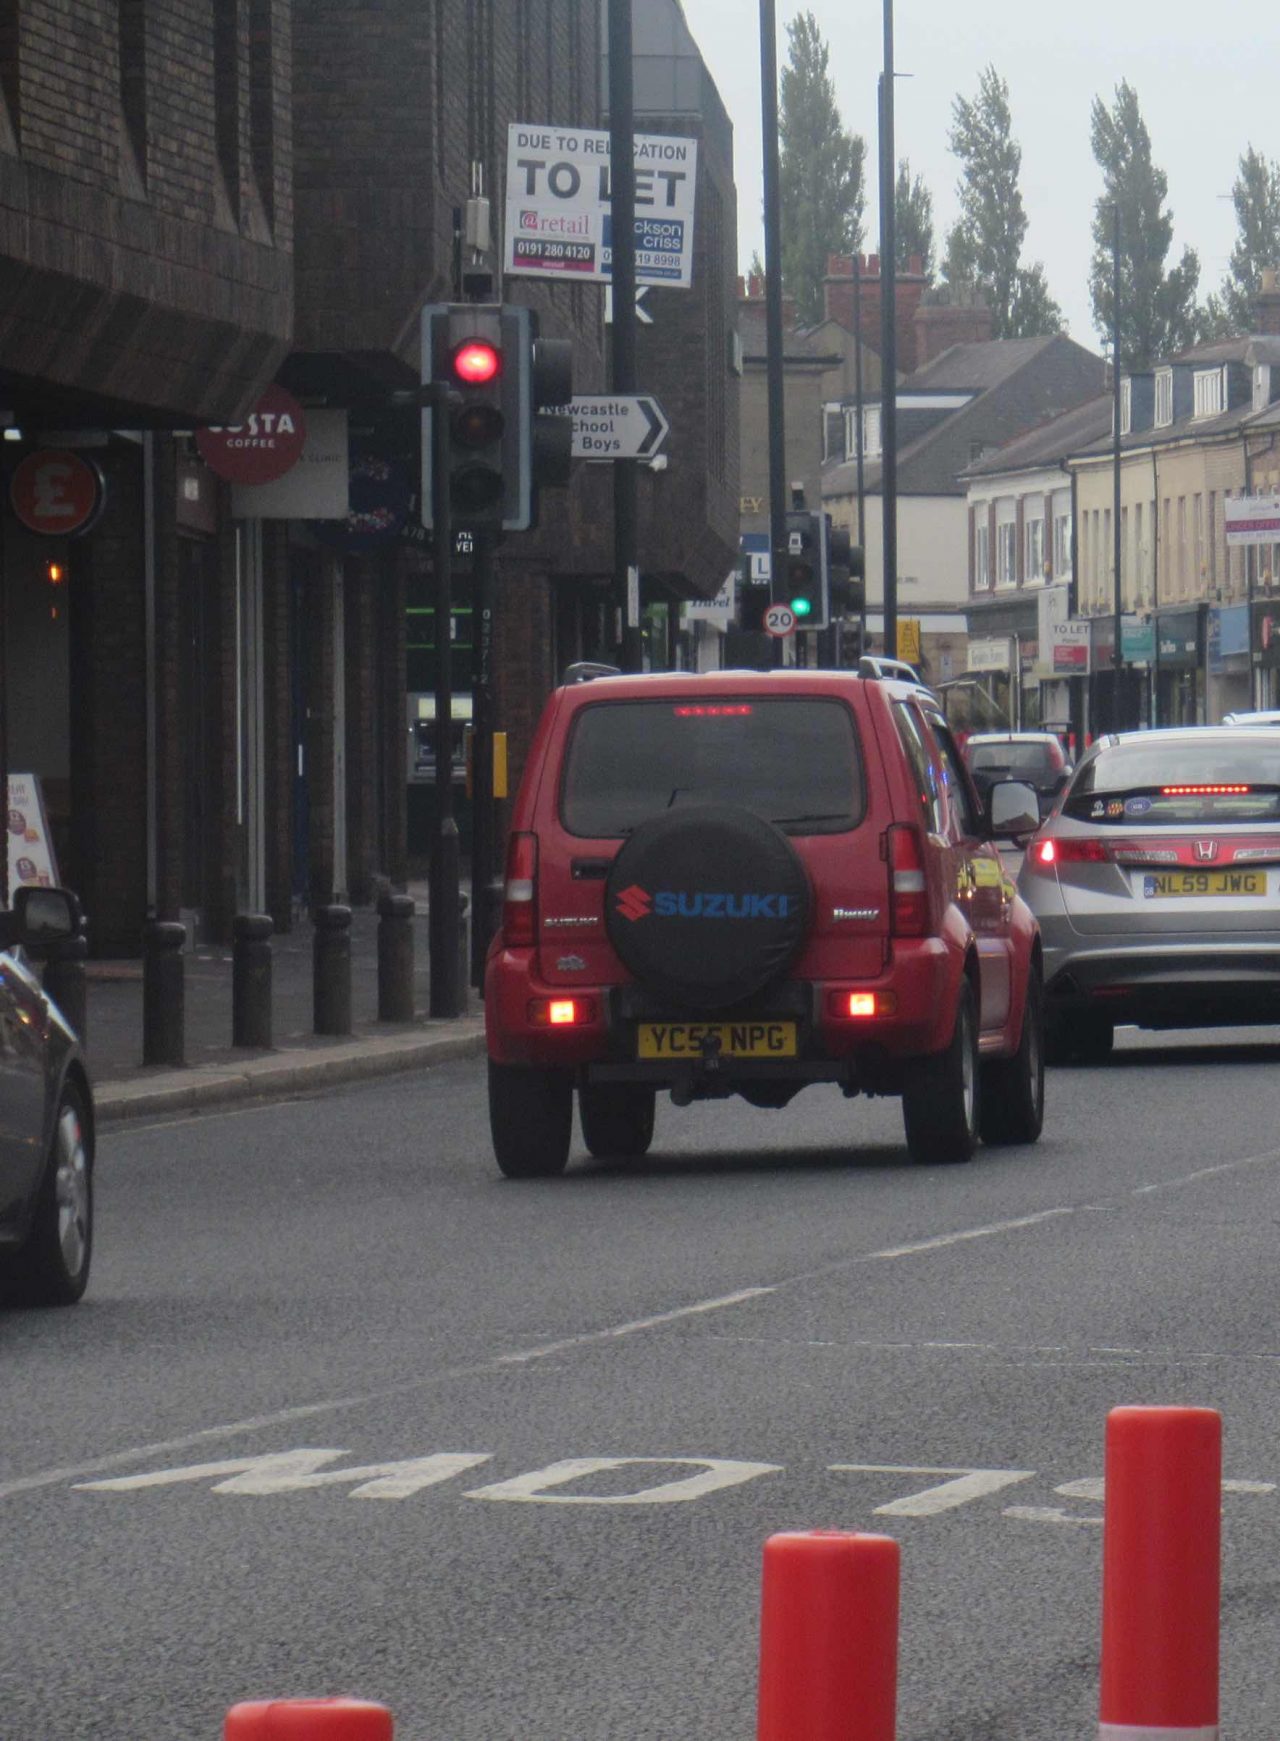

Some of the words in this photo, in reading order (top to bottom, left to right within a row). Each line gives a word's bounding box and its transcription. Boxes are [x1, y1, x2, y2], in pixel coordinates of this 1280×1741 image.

[517, 133, 551, 150] DUE
[556, 136, 578, 152] TO
[517, 159, 581, 199] TO
[517, 241, 542, 255] 0191
[544, 244, 564, 258] 280
[565, 246, 591, 260] 4120
[642, 235, 682, 249] criss
[208, 412, 296, 435] STA
[571, 420, 615, 433] chool
[226, 438, 276, 449] COFFEE
[582, 436, 621, 453] Boys
[768, 613, 792, 627] 20
[1053, 624, 1068, 635] TO
[1070, 624, 1089, 635] LET
[1154, 876, 1209, 894] NL59
[1216, 875, 1257, 893] JWG
[654, 891, 789, 918] SUZUKI
[729, 1025, 786, 1052] NPG
